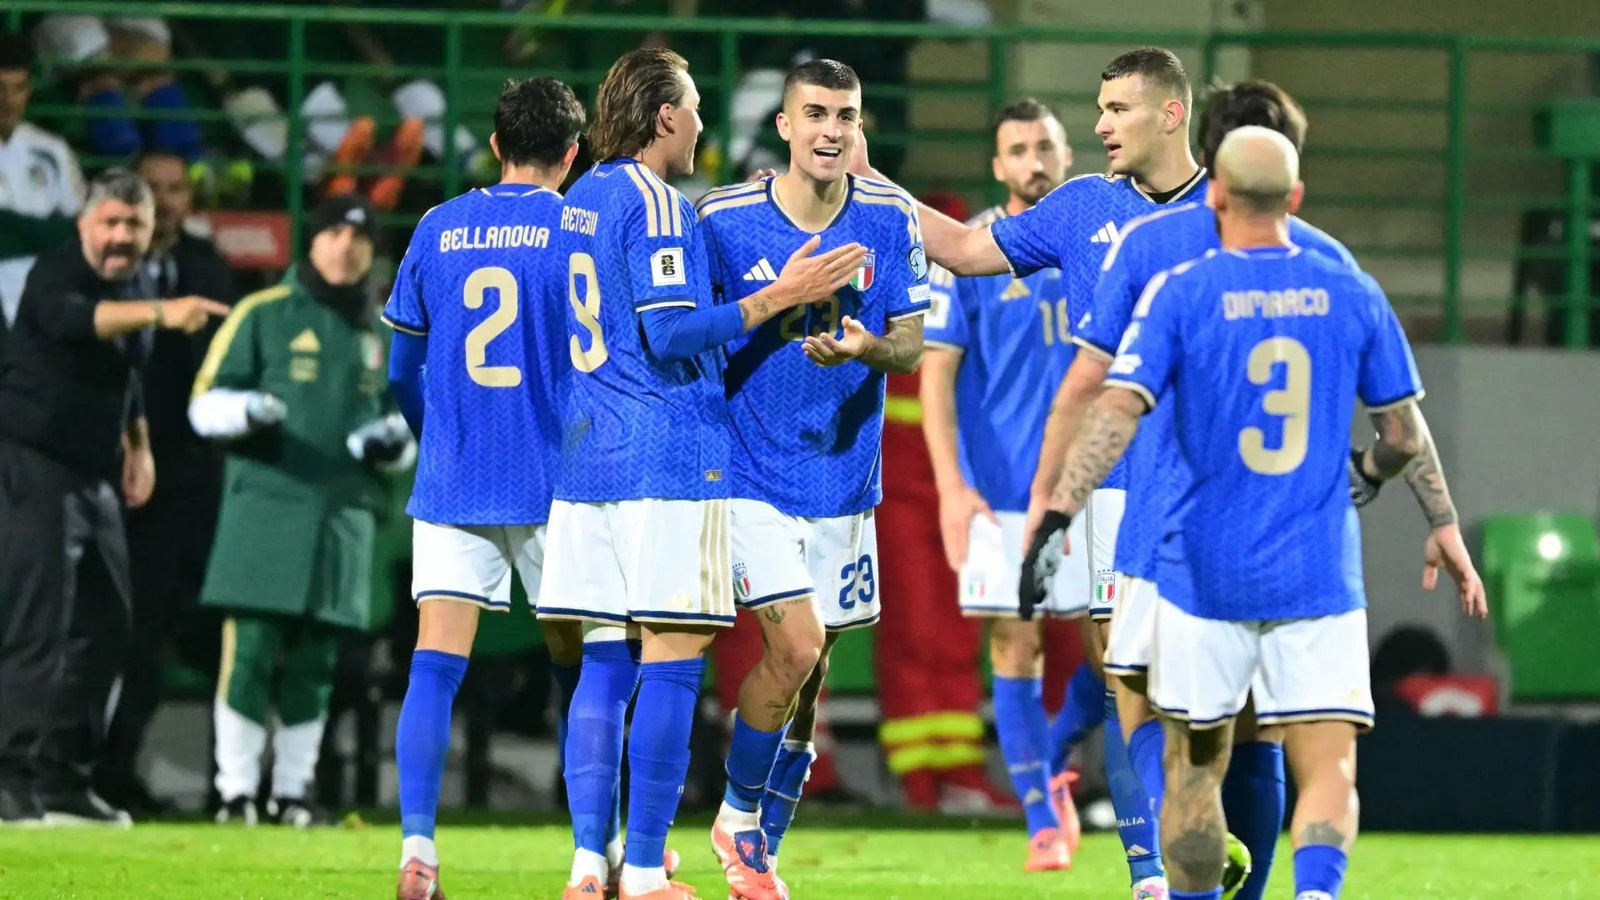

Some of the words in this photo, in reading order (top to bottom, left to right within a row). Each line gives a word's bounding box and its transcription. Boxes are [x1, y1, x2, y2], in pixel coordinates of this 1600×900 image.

[439, 225, 550, 253] BELLANOVA
[463, 266, 522, 387] 2
[569, 252, 609, 373] 9
[1222, 288, 1330, 321] DIMARCO
[1238, 336, 1312, 476] 3
[839, 554, 875, 610] 23
